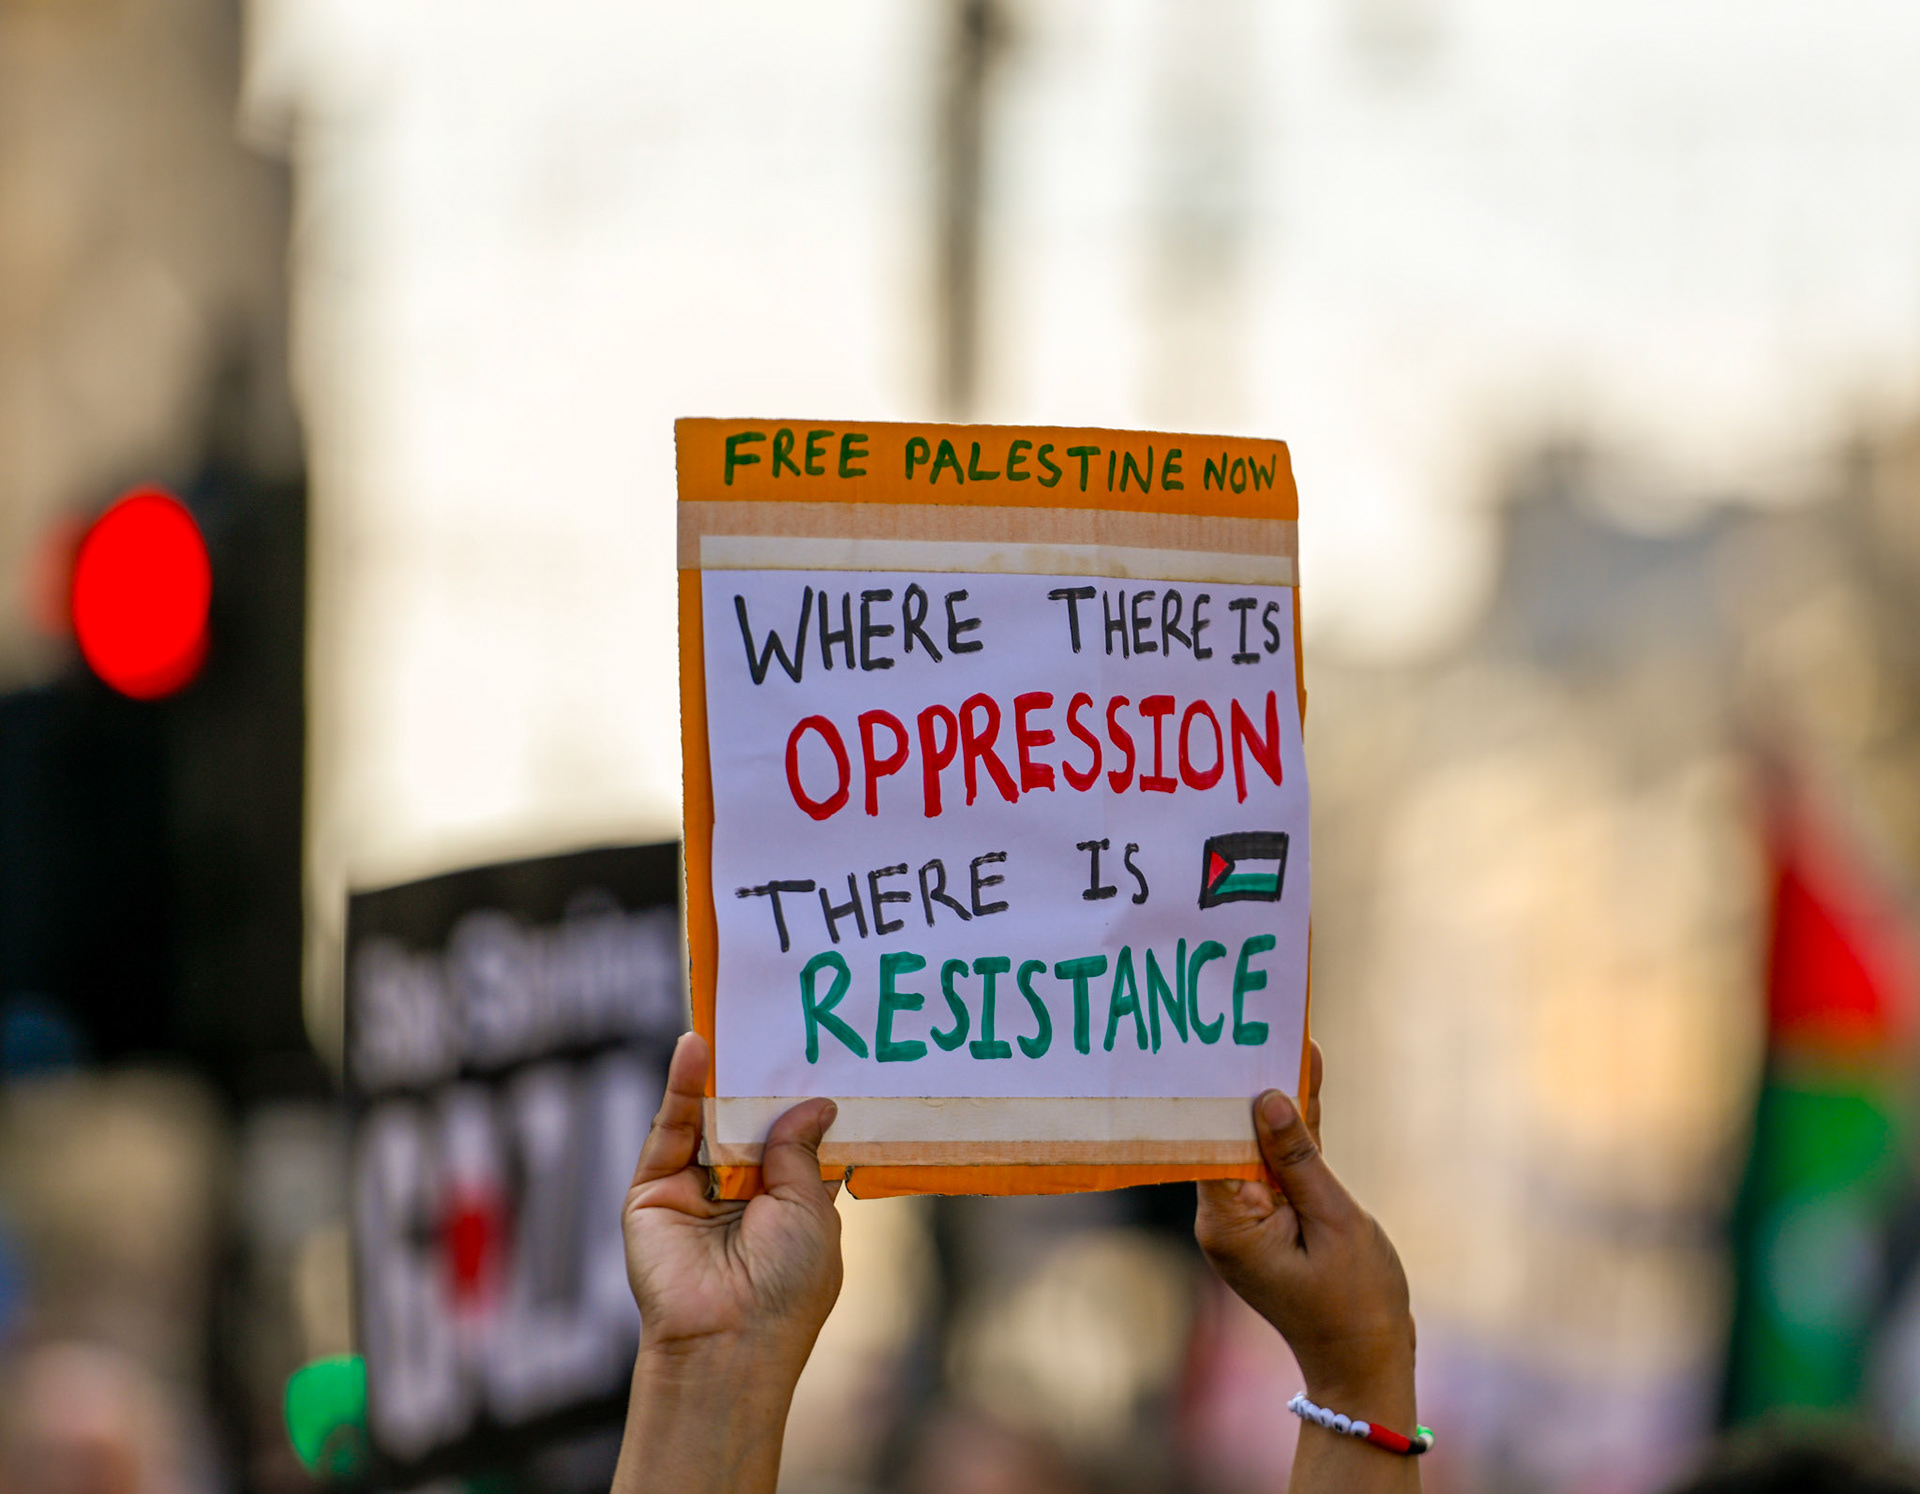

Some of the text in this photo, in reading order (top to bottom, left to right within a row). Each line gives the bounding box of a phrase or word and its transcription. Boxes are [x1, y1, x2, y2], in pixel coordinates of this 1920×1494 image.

[724, 428, 1277, 494] FREE PALESTINE NOW
[734, 583, 1280, 686] WHERE THERE IS
[785, 690, 1283, 821] OPPRESSION
[735, 838, 1149, 953] THERE IS
[799, 934, 1277, 1065] RESISTANCE
